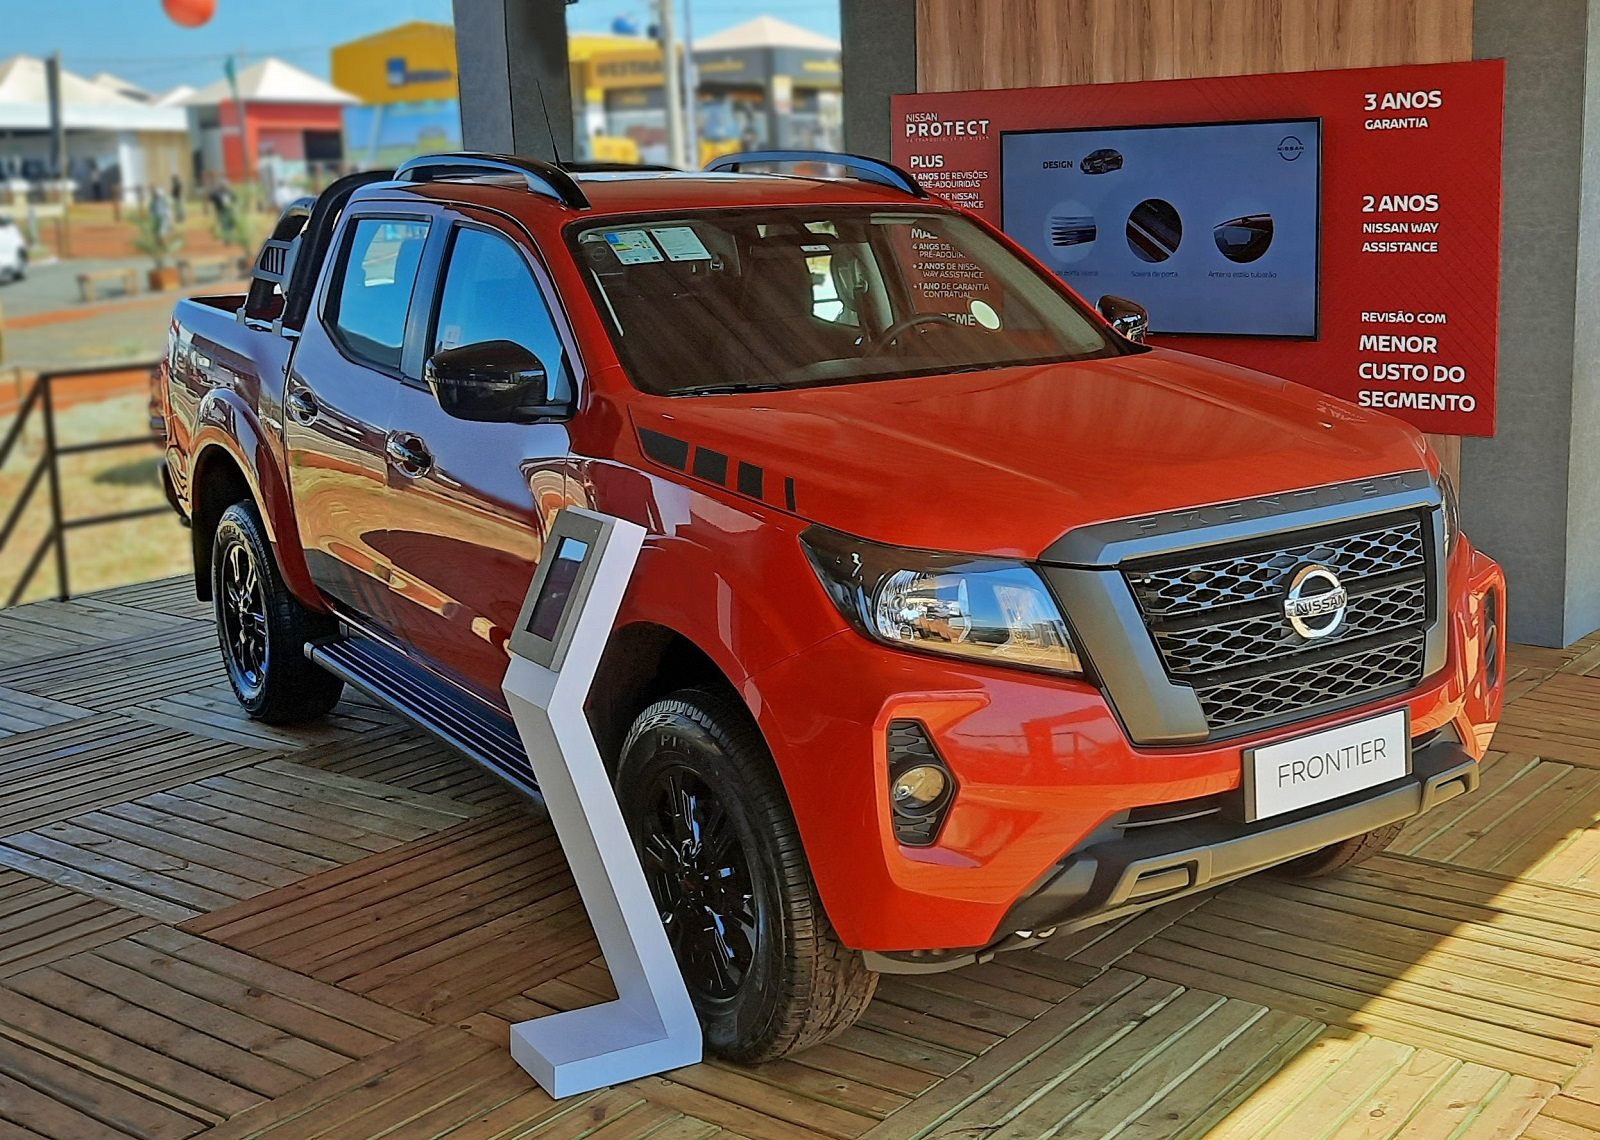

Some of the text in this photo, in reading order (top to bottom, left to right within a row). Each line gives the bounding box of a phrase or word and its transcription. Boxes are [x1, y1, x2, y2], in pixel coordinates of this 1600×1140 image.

[1364, 90, 1442, 111] 3 ANOS
[906, 112, 938, 122] NISSAN
[1364, 117, 1428, 130] GARANTIA
[905, 120, 989, 137] PROTECT
[910, 155, 944, 168] PLUS
[1043, 160, 1073, 169] DESIGN
[918, 172, 939, 180] ANOS
[940, 172, 951, 180] DE
[951, 170, 988, 179] REVISÕES
[952, 192, 979, 200] NISSAN
[1362, 194, 1439, 212] 2 ANOS
[1362, 222, 1439, 233] NISSAN WAY
[1362, 242, 1438, 252] ASSISTANCE
[918, 262, 924, 270] 2
[946, 263, 957, 271] DE
[939, 271, 985, 279] ASSISTANCE
[952, 283, 990, 291] GARANTIA
[1361, 311, 1447, 324] REVISÃO COM
[1359, 335, 1438, 354] MENOR
[1358, 362, 1466, 383] CUSTO DO
[1358, 390, 1476, 412] SEGMENTO
[1295, 593, 1345, 615] NISSAN
[1278, 737, 1387, 788] FRONTIER
